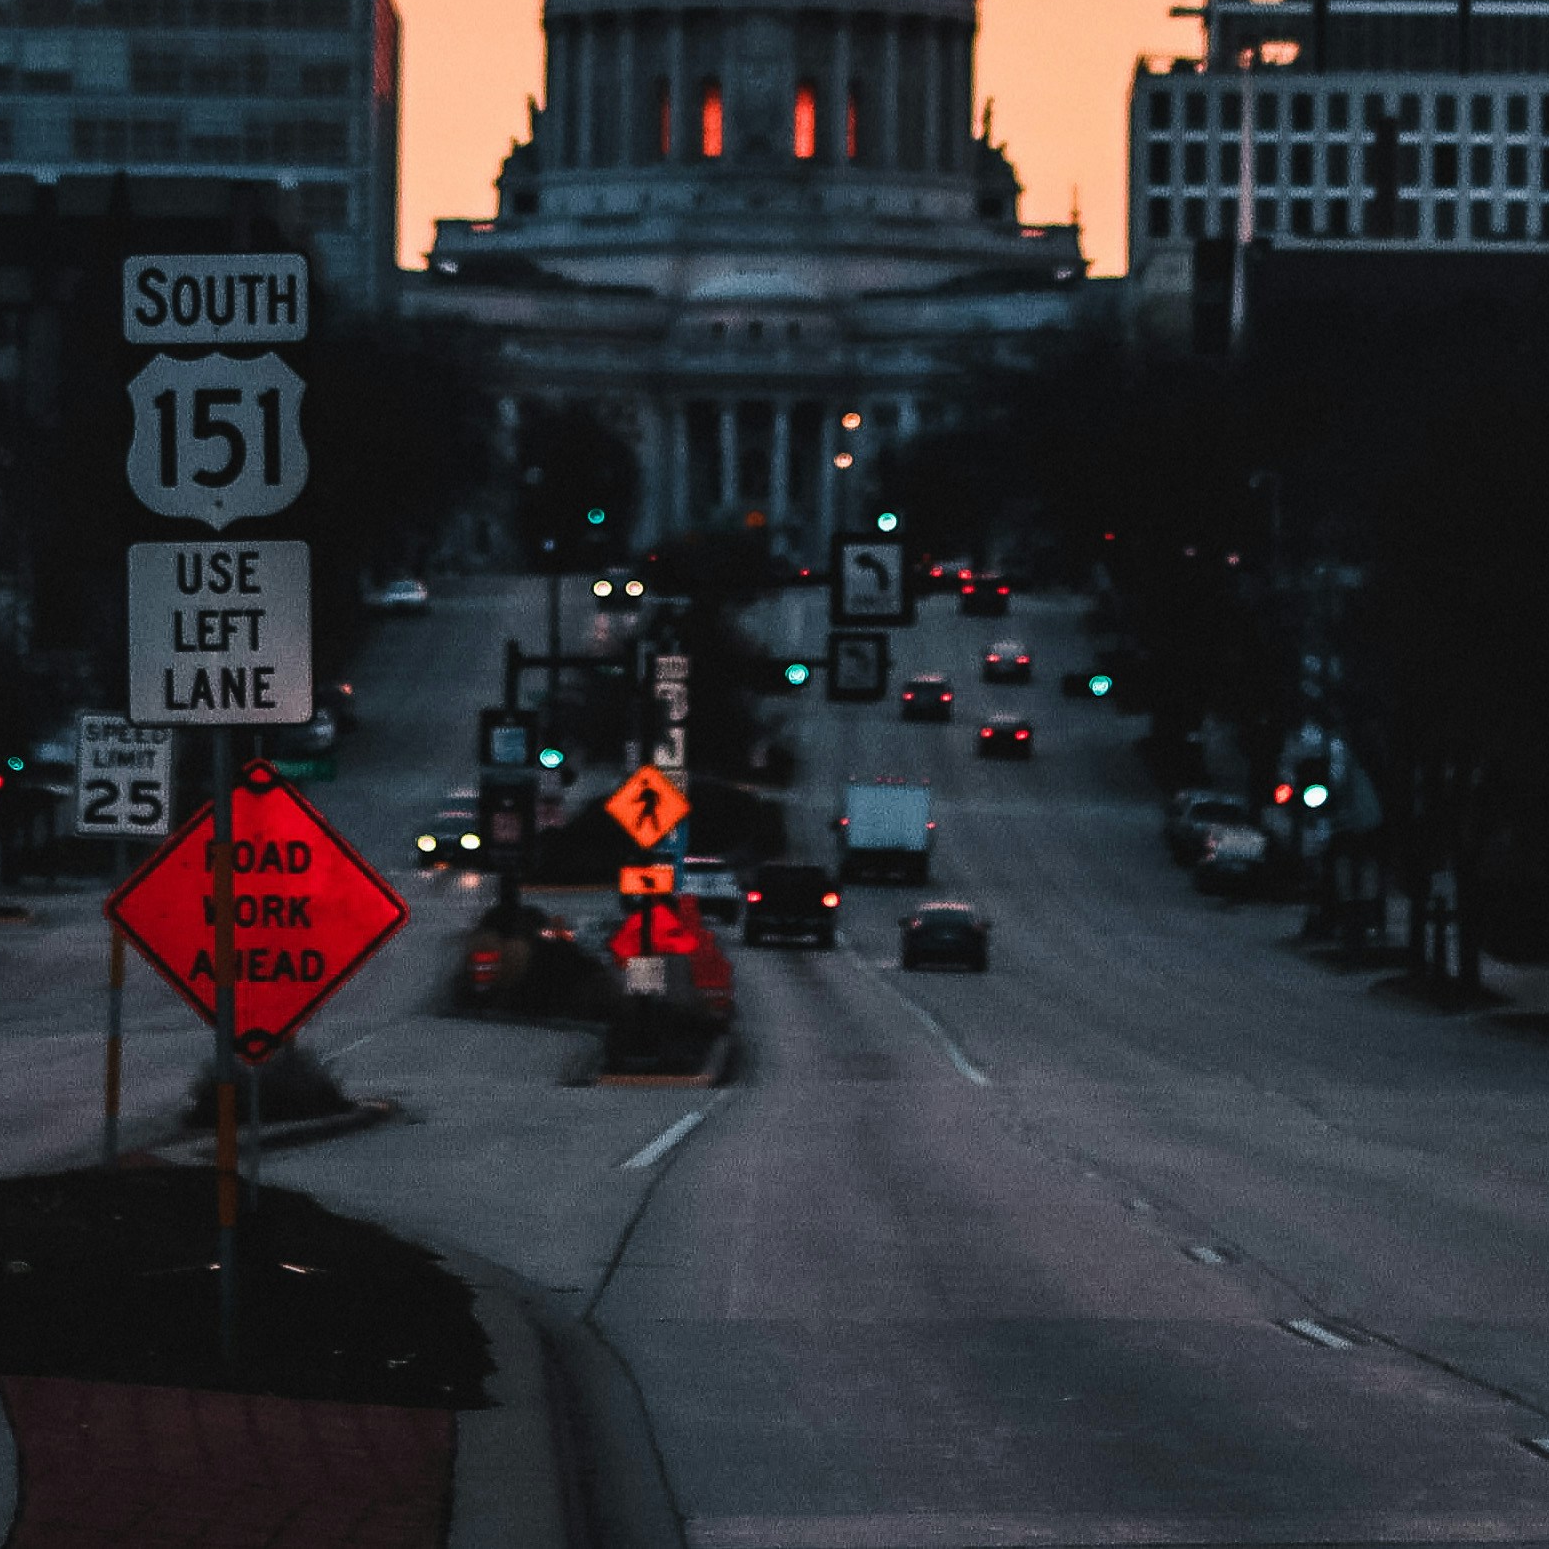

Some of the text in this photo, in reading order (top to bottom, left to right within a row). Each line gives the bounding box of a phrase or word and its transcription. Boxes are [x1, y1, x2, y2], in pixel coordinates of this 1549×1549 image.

[135, 269, 297, 327] SOUTH
[153, 388, 282, 488] 151
[177, 551, 261, 595] USE
[173, 610, 265, 653] LEFT
[164, 667, 276, 711] LANE
[85, 722, 168, 744] SPEED
[93, 750, 156, 769] LIMIT
[83, 780, 163, 826] 25
